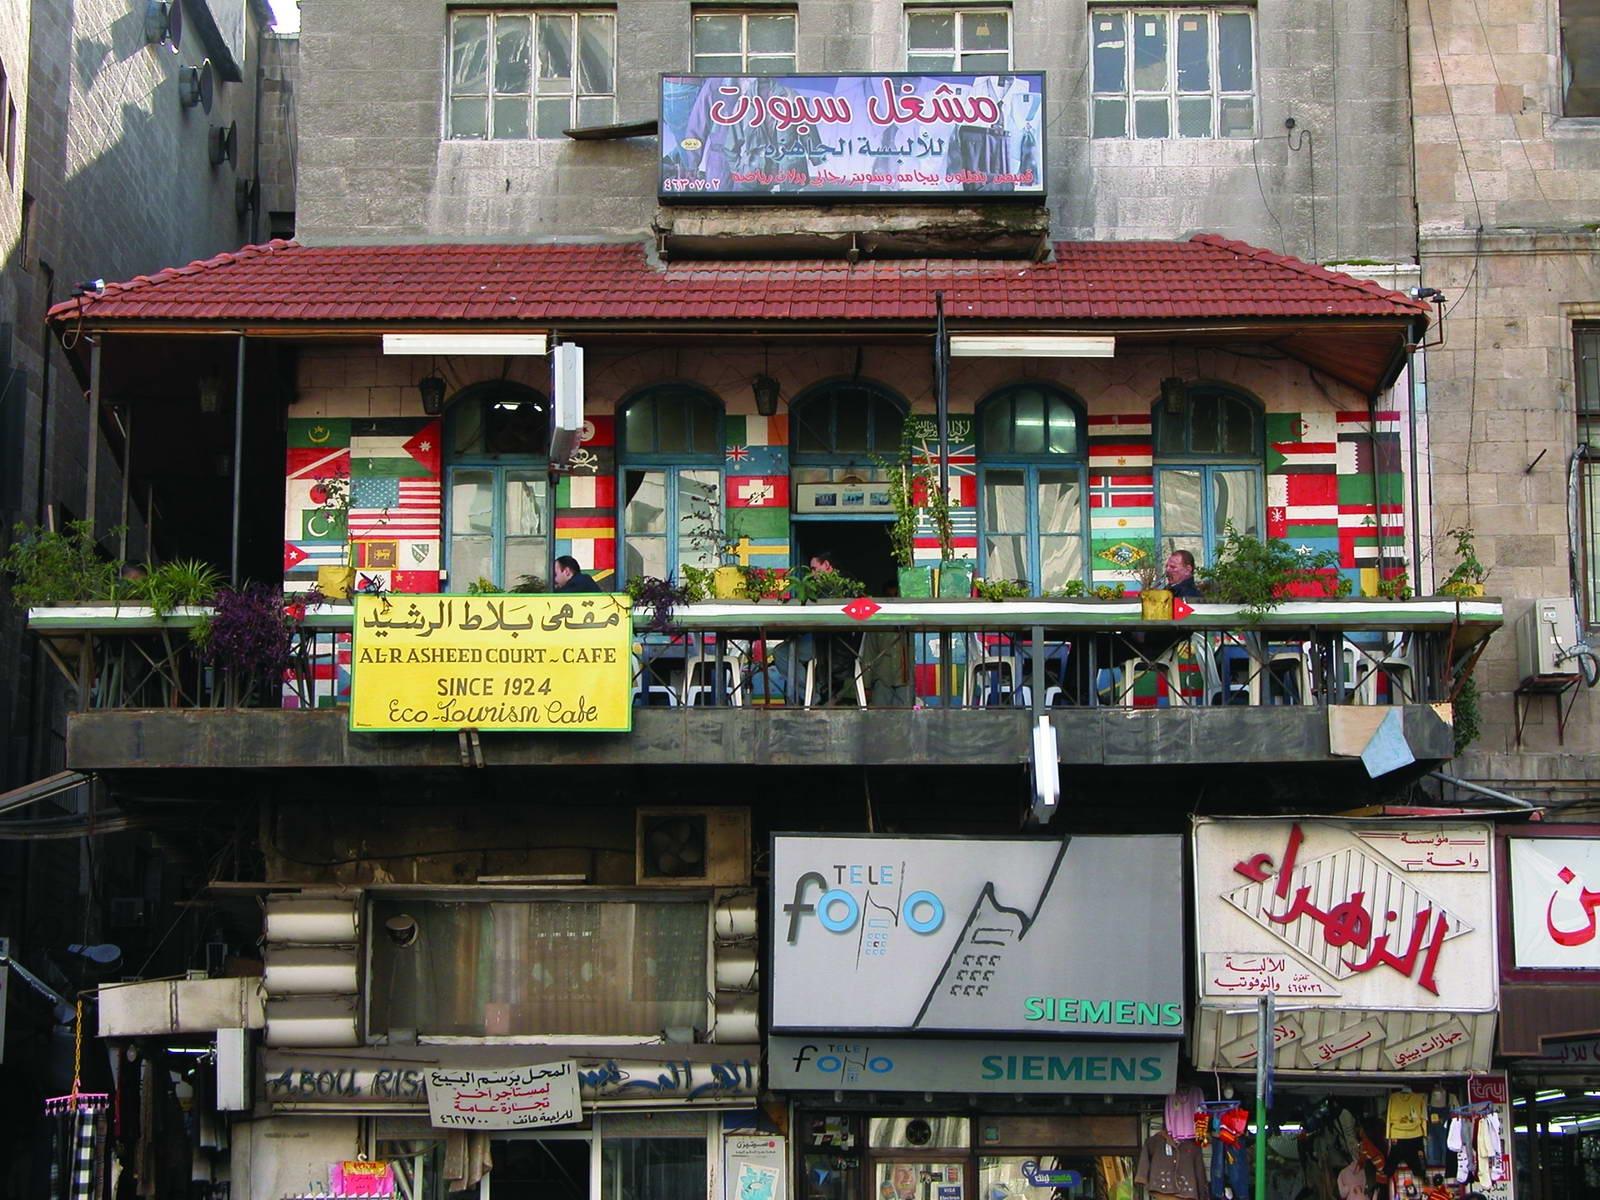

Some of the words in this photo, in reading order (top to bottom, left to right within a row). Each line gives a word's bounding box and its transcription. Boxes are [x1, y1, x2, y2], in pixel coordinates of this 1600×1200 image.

[710, 86, 852, 135] سبورت
[868, 79, 1001, 126] مشغل
[485, 648, 546, 664] COURT
[563, 648, 616, 663] CAFE
[437, 677, 494, 696] SINCE
[503, 677, 552, 696] 1924
[544, 695, 598, 723] Cafe
[1401, 832, 1449, 846] مؤسسة
[1426, 851, 1479, 868] واحة
[833, 865, 893, 885] TELE
[1233, 822, 1449, 996] الزهراء
[1024, 997, 1182, 1026] SIEMENS
[828, 1044, 862, 1053] TELE
[522, 1063, 571, 1085] المحل
[981, 1055, 1162, 1082] SIEMENS
[371, 1067, 428, 1098] RIS
[431, 1071, 475, 1087] البيع
[477, 1073, 521, 1089] برسم
[454, 1101, 499, 1113] عامة
[501, 1098, 550, 1114] تجارة
[512, 1112, 538, 1125] هاتف
